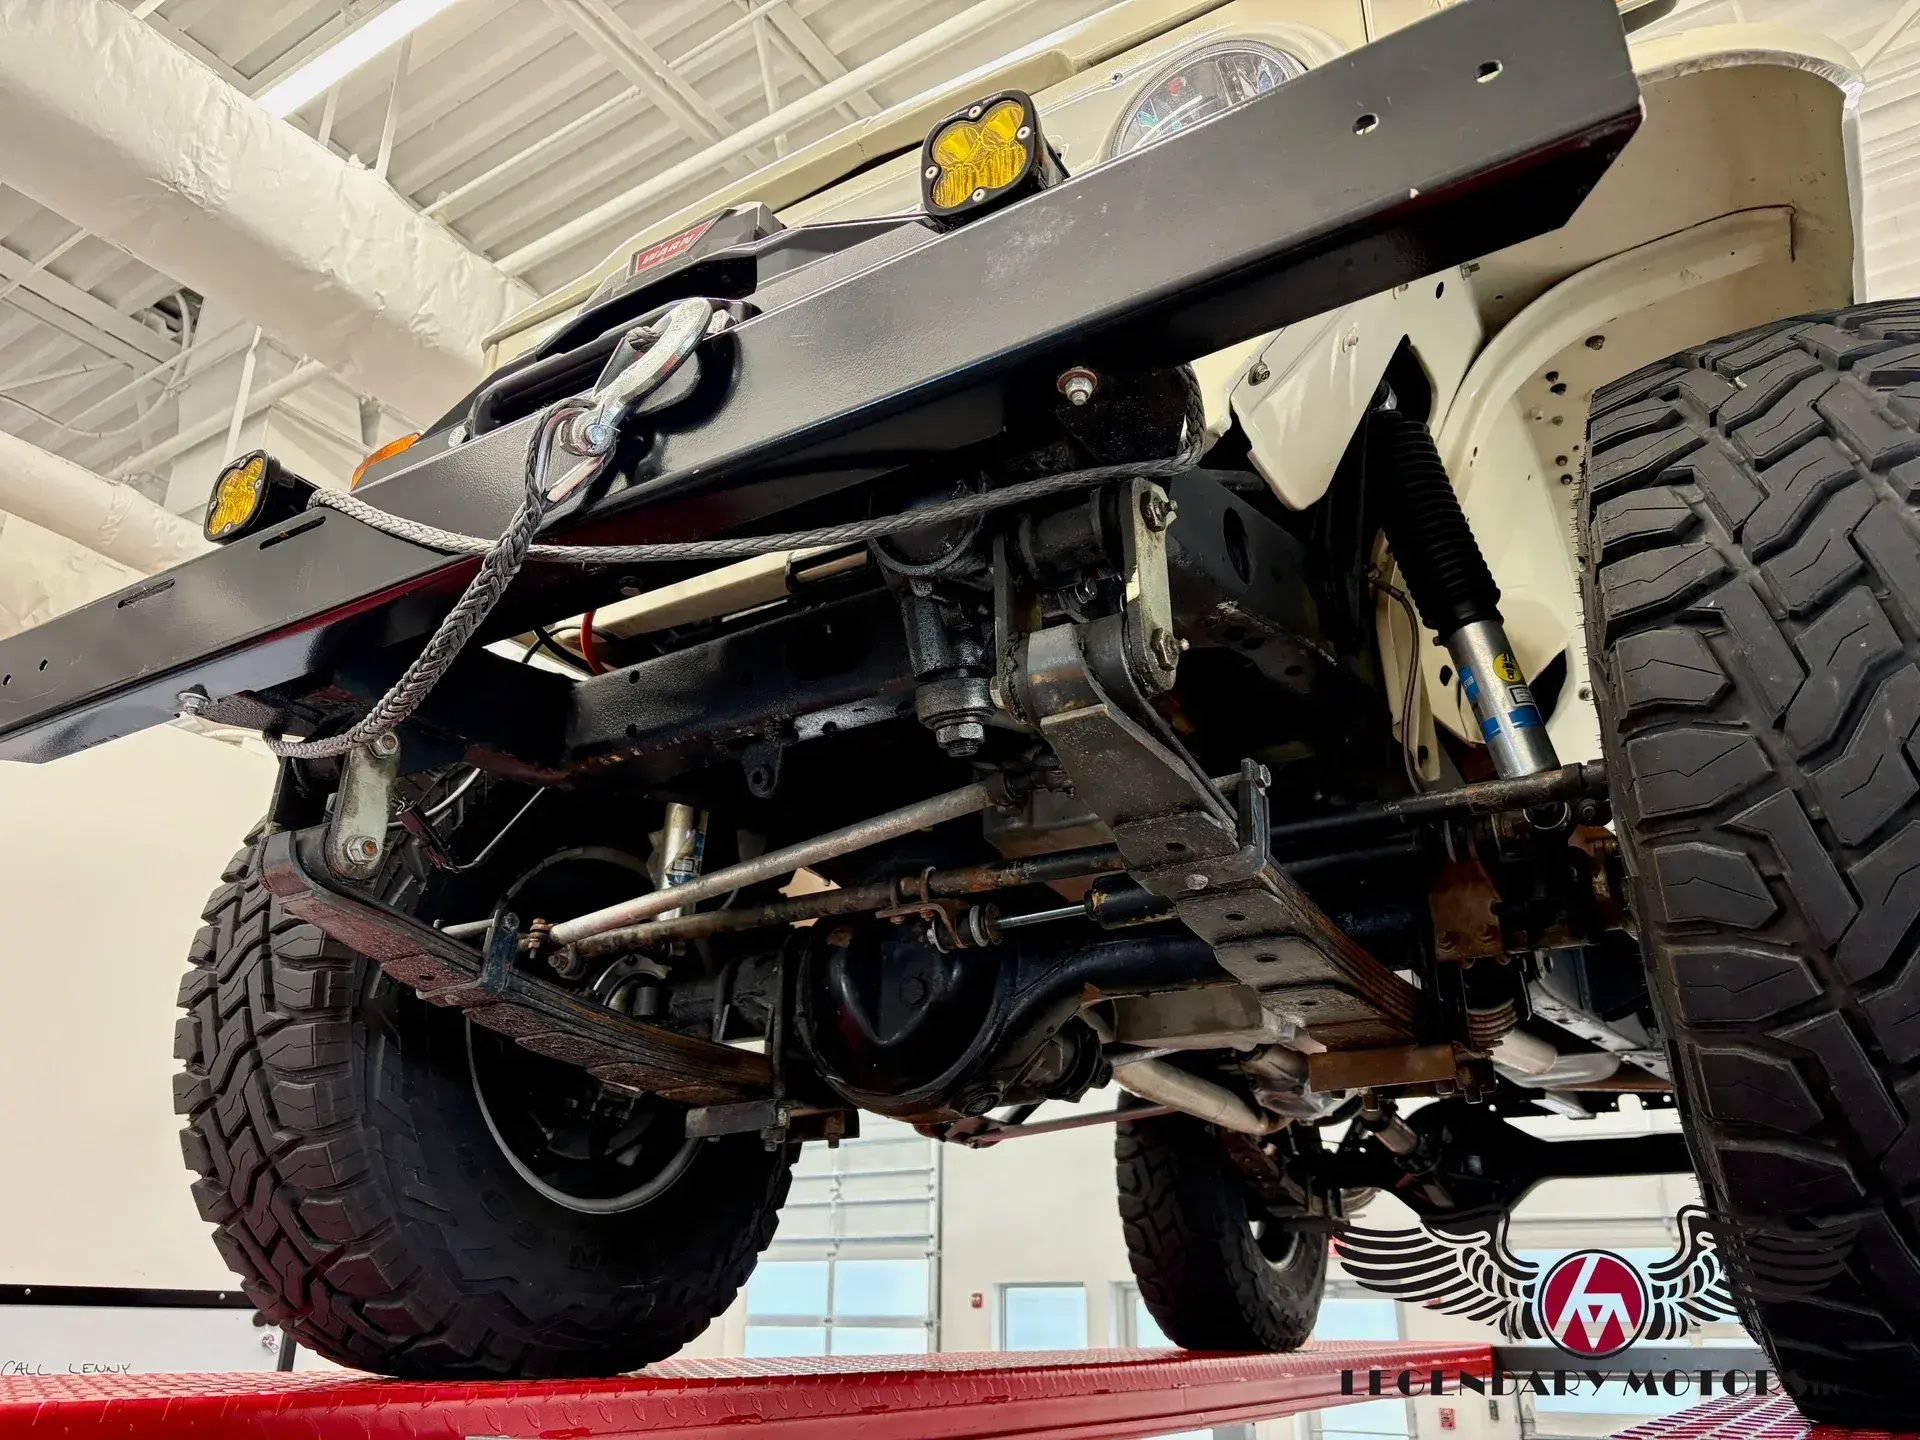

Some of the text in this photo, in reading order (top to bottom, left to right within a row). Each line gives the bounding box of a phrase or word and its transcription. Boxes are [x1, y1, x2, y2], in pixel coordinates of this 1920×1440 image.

[641, 234, 695, 265] WARN
[1, 1360, 131, 1376] CALL LENNY
